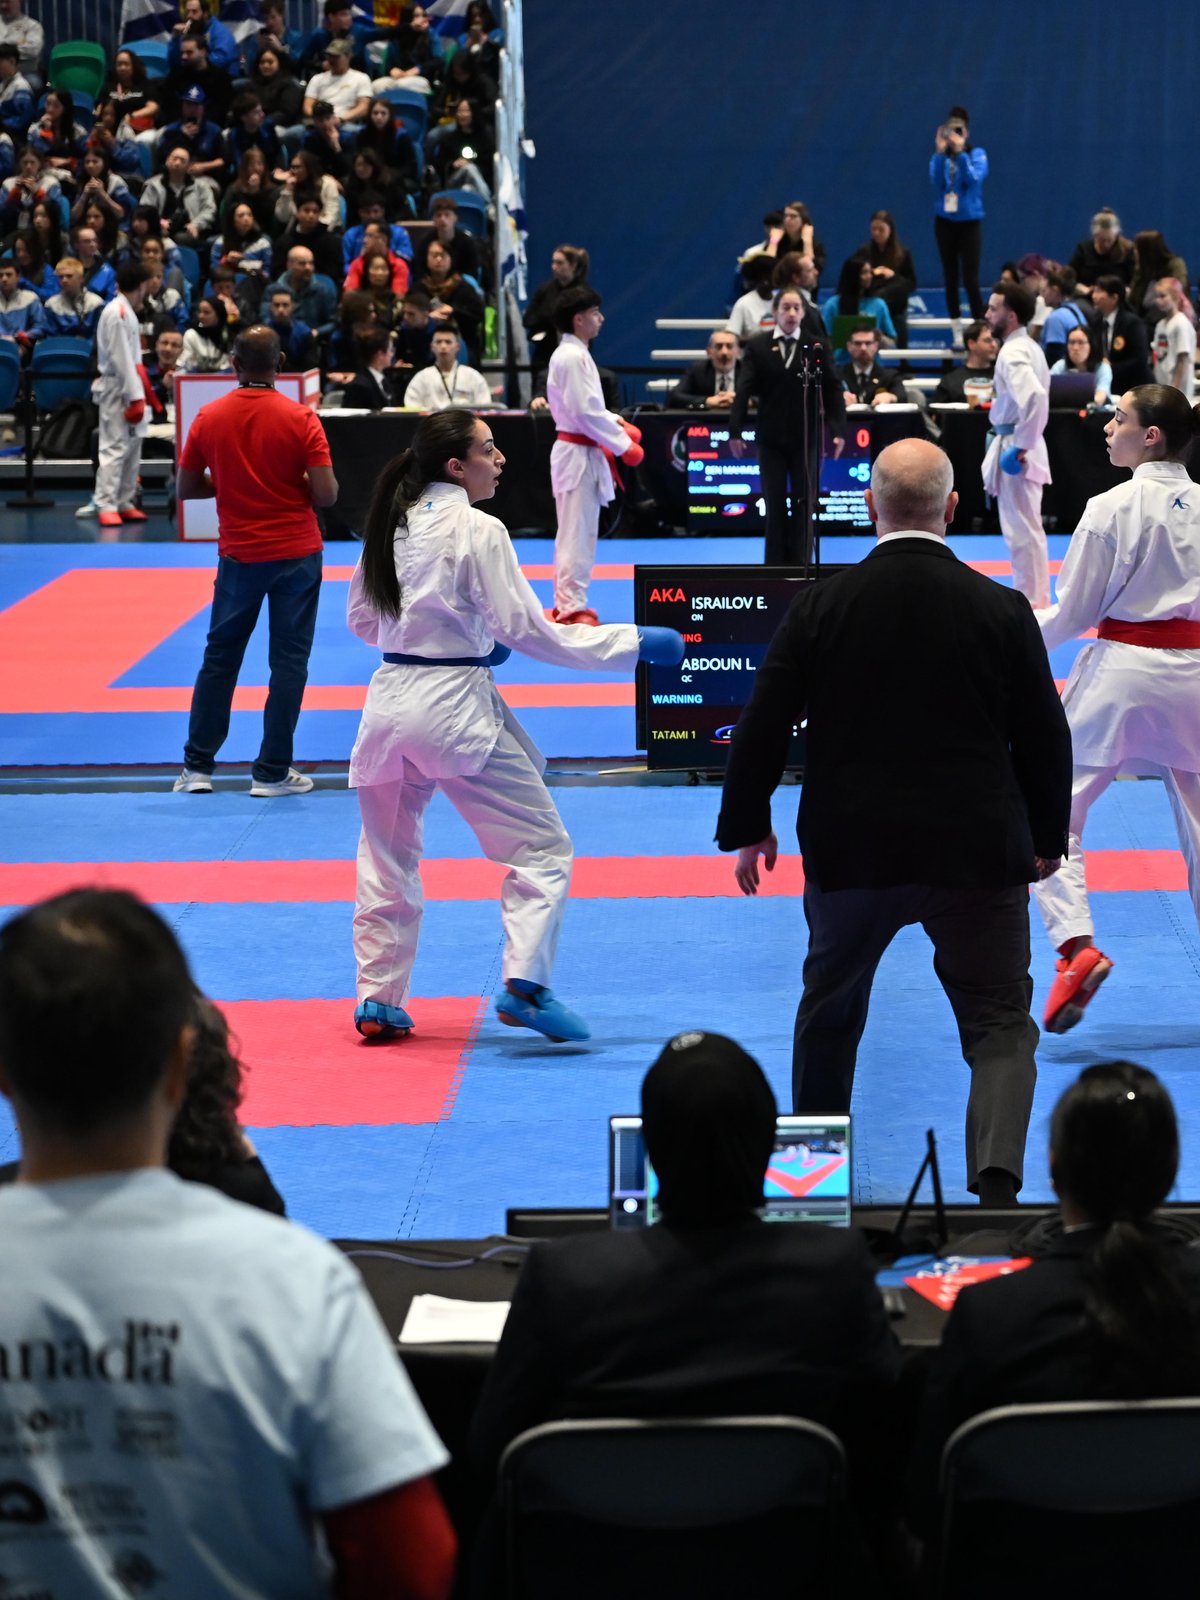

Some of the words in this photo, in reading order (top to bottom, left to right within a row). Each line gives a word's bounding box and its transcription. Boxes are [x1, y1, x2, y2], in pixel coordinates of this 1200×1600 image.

[856, 428, 870, 448] 0
[650, 588, 686, 603] AKA
[691, 596, 753, 610] ISRAILOV
[756, 596, 768, 610] E.
[691, 613, 703, 622] ON
[681, 658, 742, 671] ABDOUN
[745, 658, 756, 671] L.
[681, 674, 693, 683] QC
[652, 694, 703, 704] WARNING
[652, 730, 688, 740] TATAMI
[691, 730, 696, 740] 1
